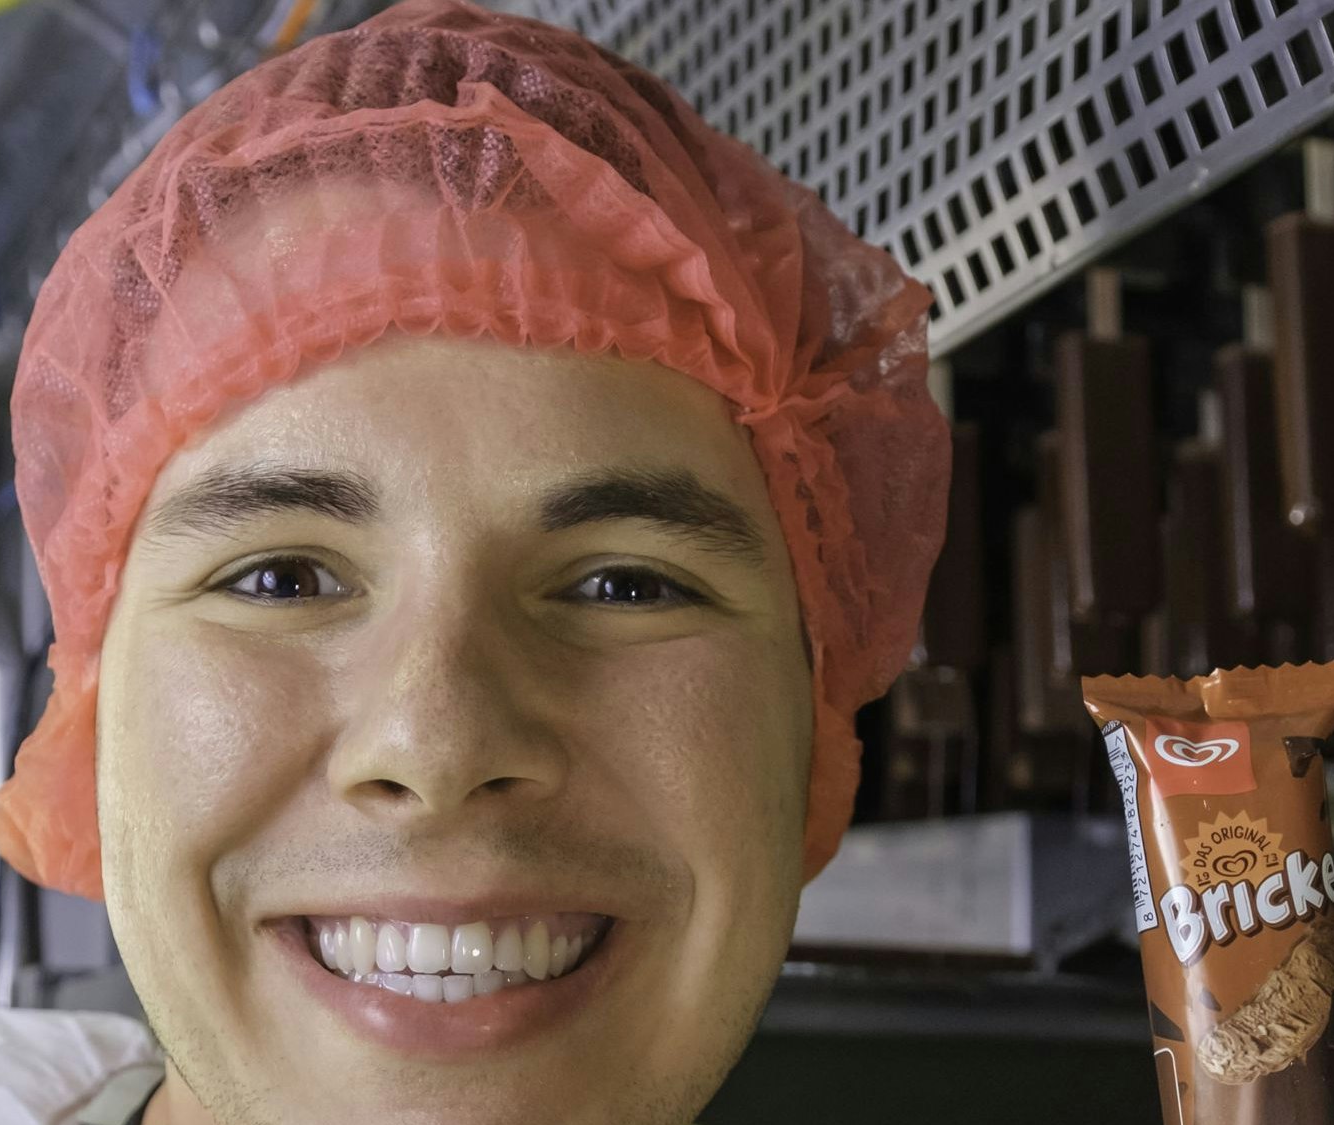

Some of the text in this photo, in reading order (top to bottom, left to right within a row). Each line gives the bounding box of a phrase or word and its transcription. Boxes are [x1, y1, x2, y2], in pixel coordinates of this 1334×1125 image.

[1194, 825, 1271, 868] DAS ORIGINAL
[1131, 829, 1149, 900] 721274
[1263, 853, 1278, 864] 73
[1195, 871, 1210, 883] 19
[1144, 912, 1154, 922] 8
